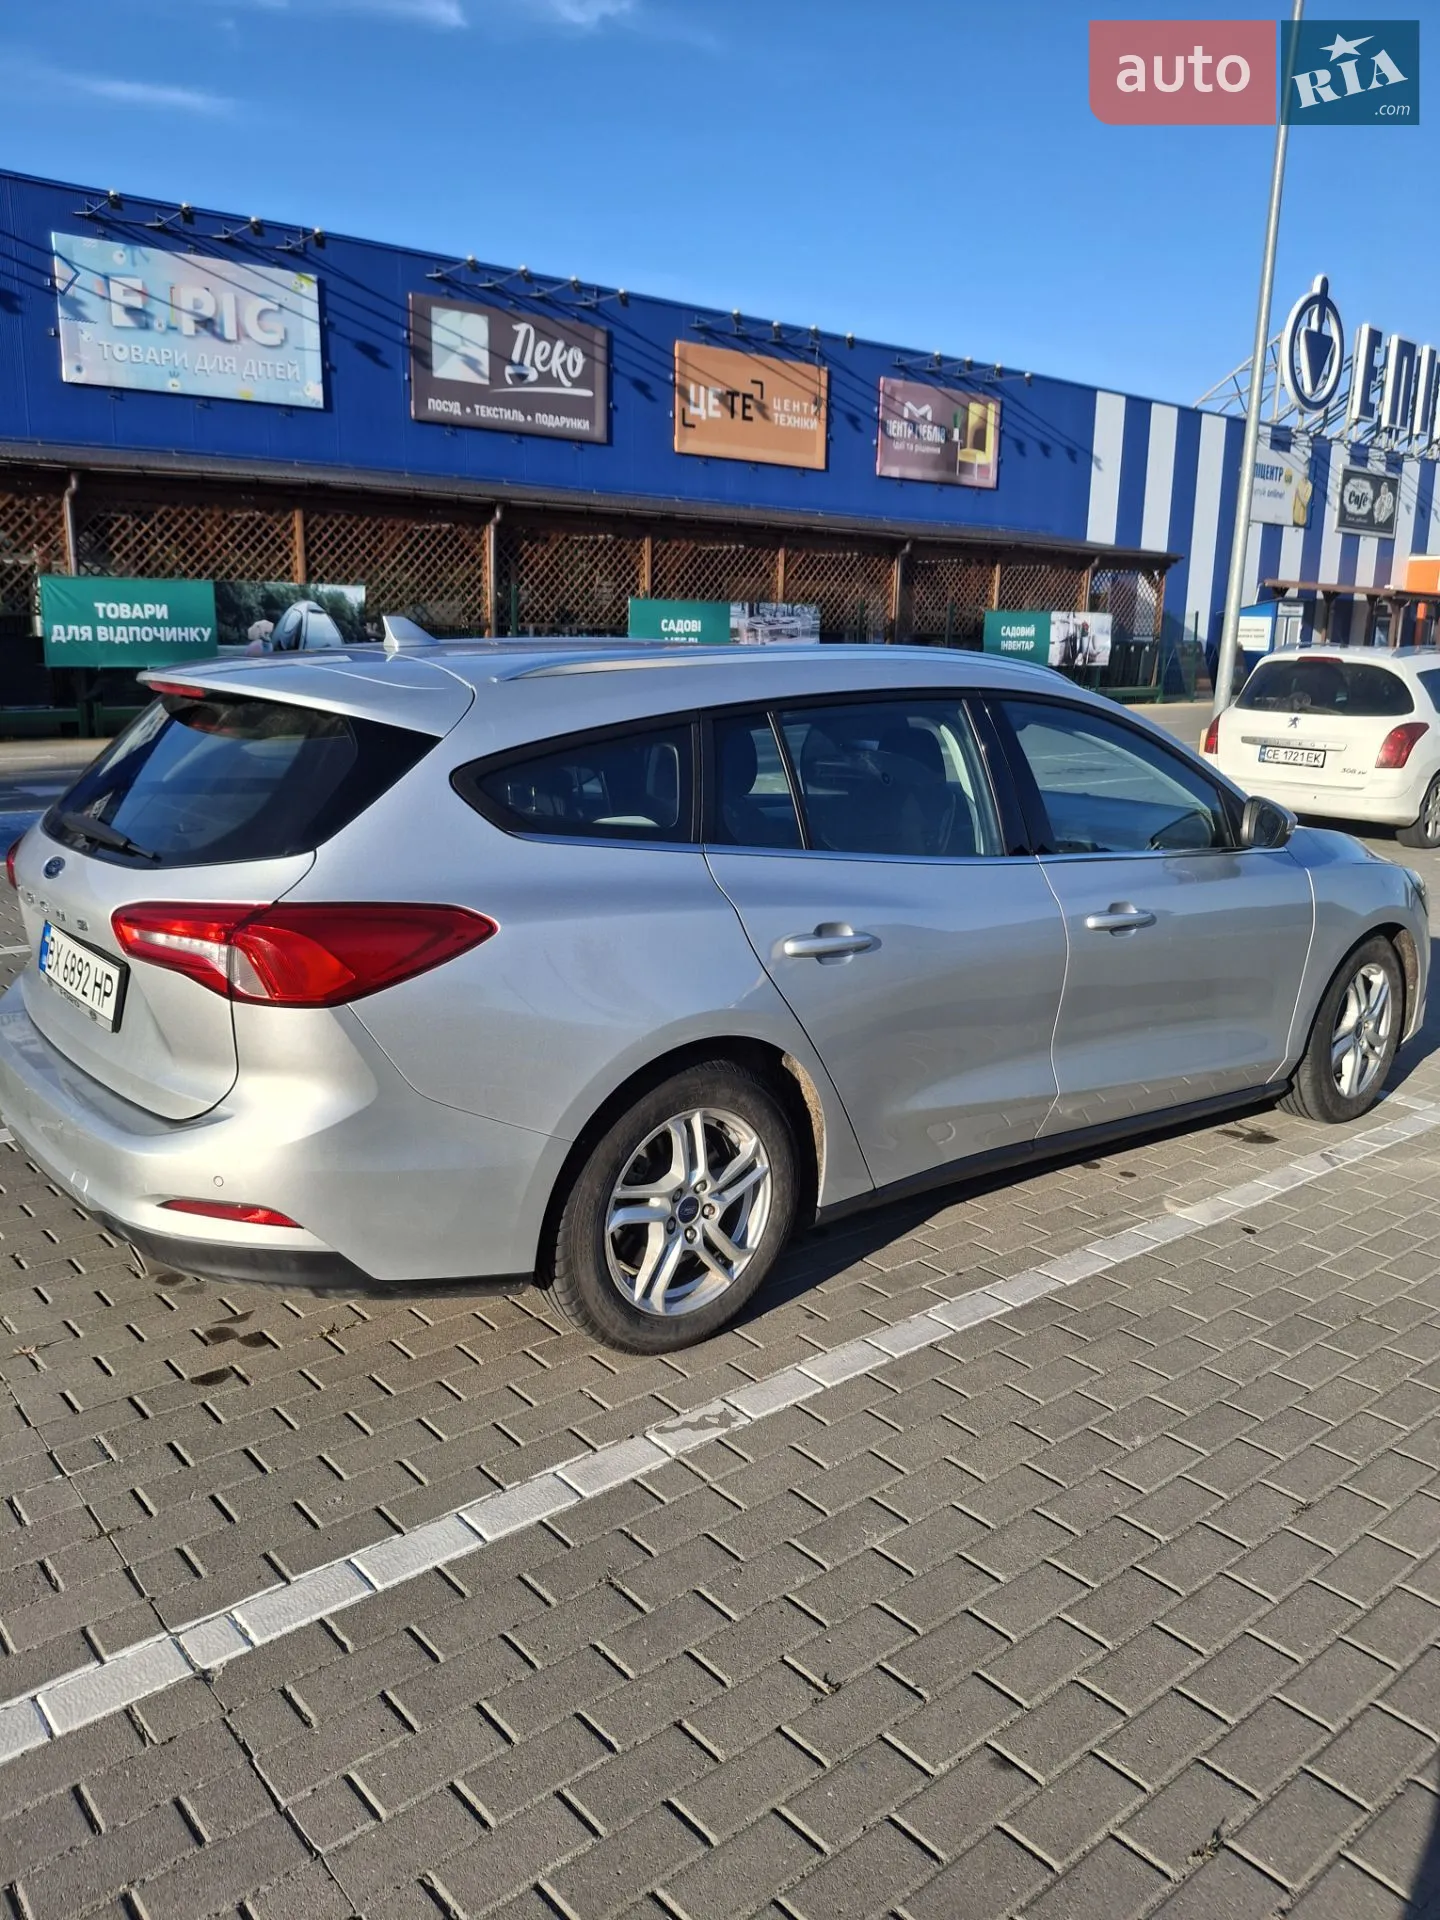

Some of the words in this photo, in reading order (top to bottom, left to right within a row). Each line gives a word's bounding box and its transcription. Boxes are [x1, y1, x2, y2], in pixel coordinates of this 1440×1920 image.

[98, 340, 188, 368] ТОВАРИ
[193, 353, 237, 376] ДЛЯ
[241, 358, 300, 382] ДІТЕЙ
[505, 323, 586, 387] Деко
[1351, 323, 1440, 440] ЕПІ
[689, 383, 754, 422] ЦЕТЕ
[428, 398, 462, 415] ПОСУД
[474, 404, 525, 422] ТЕКСТИЛЬ
[535, 414, 590, 431] ПОДАРУНКИ
[773, 413, 818, 431] ТЕХНІКИ
[94, 602, 168, 620] ТОВАРИ
[51, 625, 93, 643] ДЛЯ
[96, 626, 212, 644] ВІДПОЧИНКУ
[661, 618, 701, 633] САДОВІ
[1001, 624, 1035, 638] САДОВИЙ
[1001, 640, 1035, 651] ІНВЕНТАР
[1283, 750, 1305, 762] 1721
[62, 949, 91, 997] 6892
[92, 966, 114, 1009] HP
